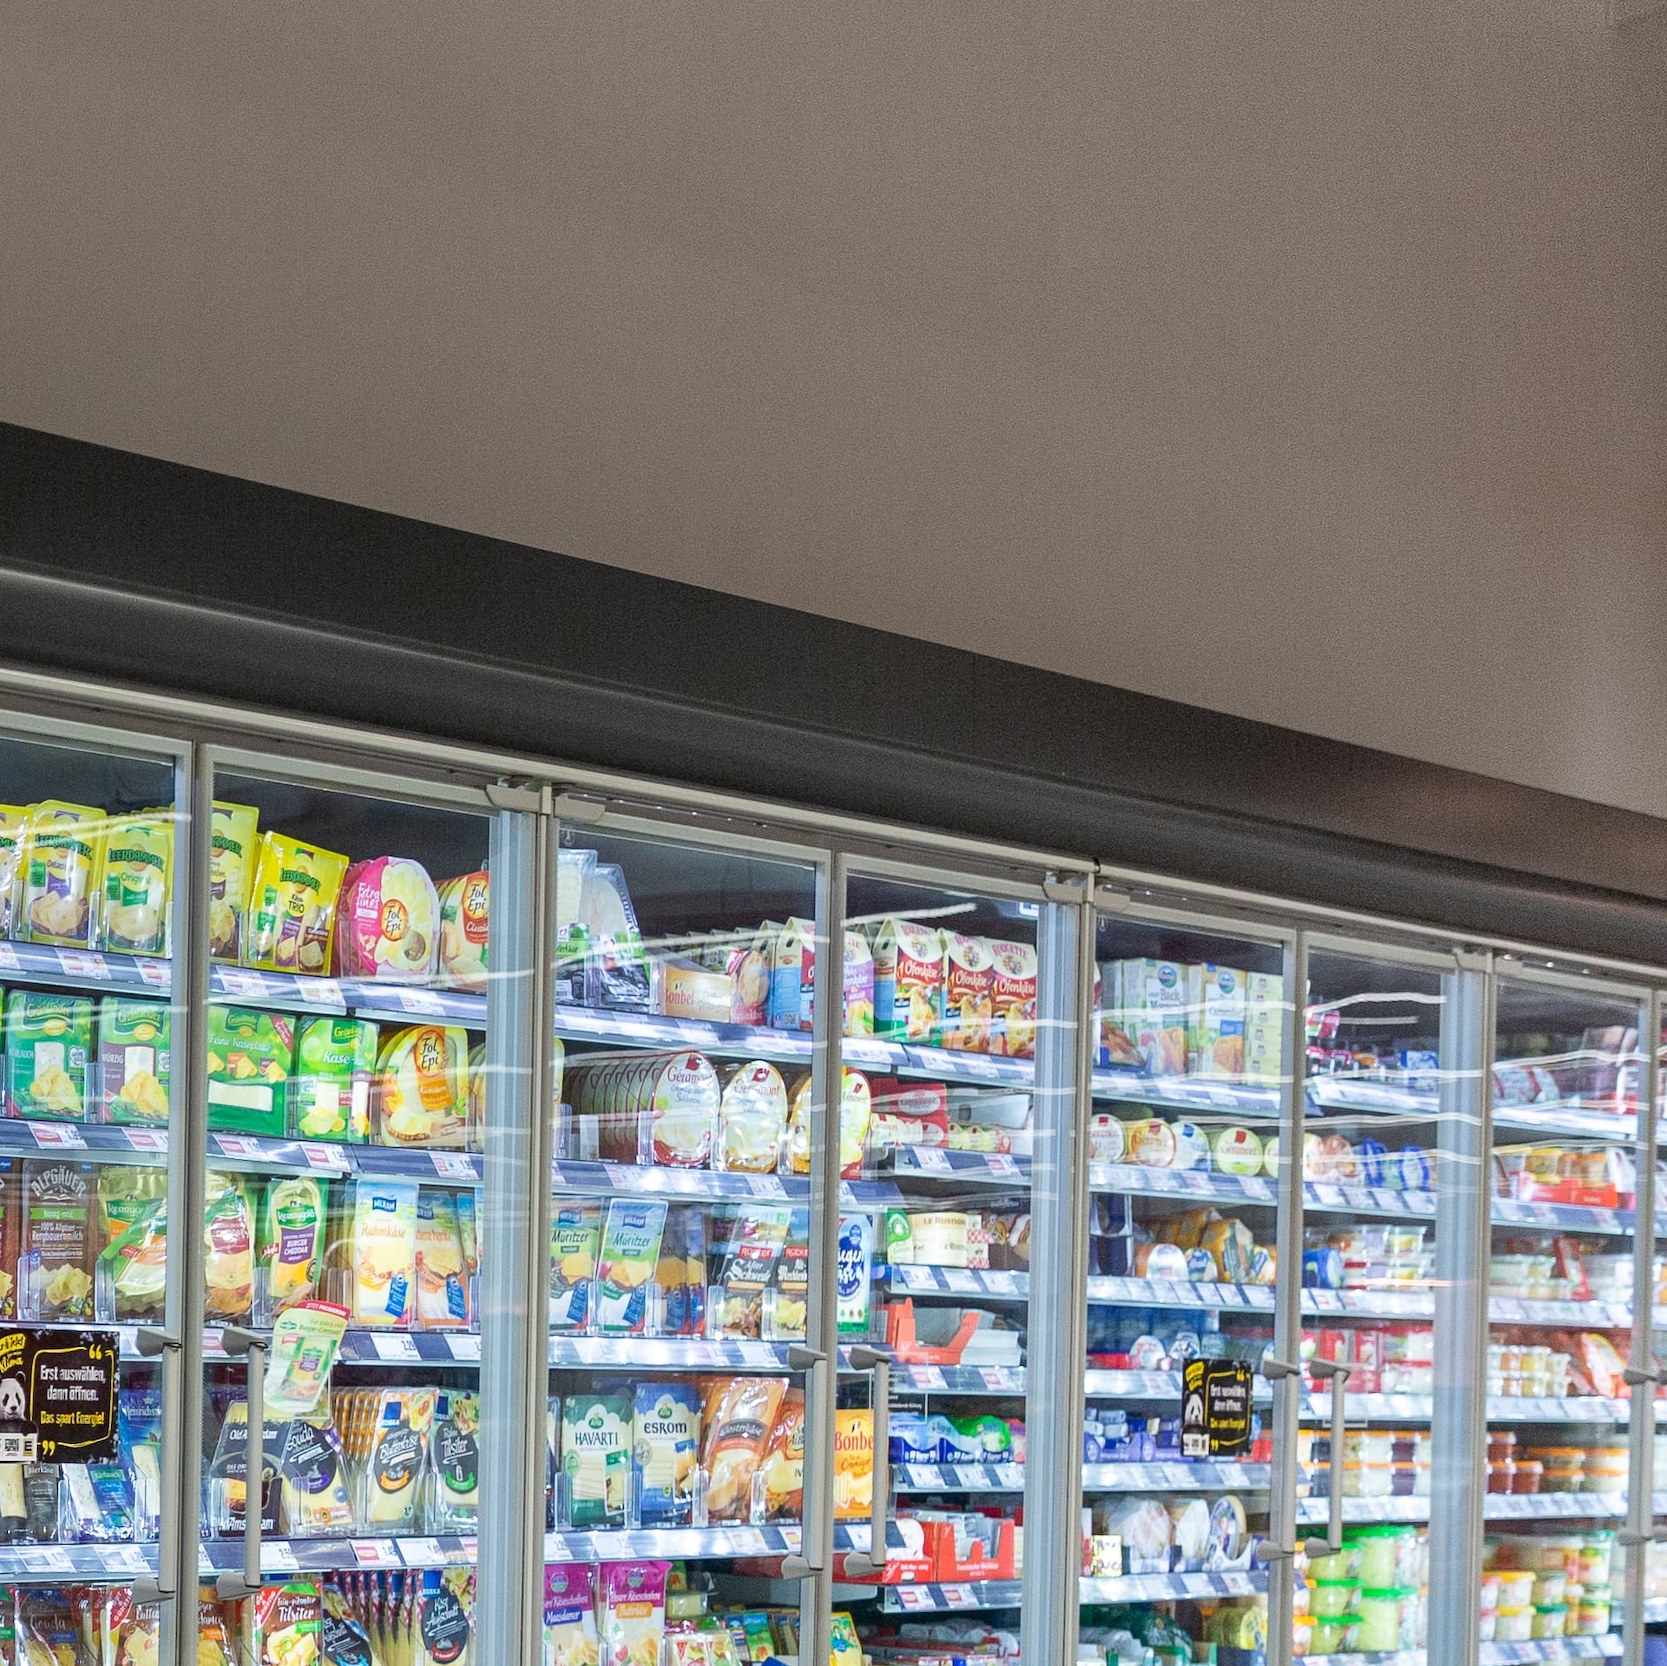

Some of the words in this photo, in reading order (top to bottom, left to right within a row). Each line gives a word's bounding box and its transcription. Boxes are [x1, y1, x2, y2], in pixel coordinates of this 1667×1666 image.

[108, 848, 164, 872] LEERDAMMER
[120, 872, 151, 885] Original
[386, 905, 401, 920] Fol
[385, 919, 401, 935] Epi
[904, 962, 943, 983] Ofenkäse
[31, 1165, 87, 1199] ALPGÄUER
[32, 1229, 84, 1242] Bergbauernmilch
[361, 1222, 406, 1238] Rahmkäse
[613, 1232, 651, 1247] Müritzer
[41, 1365, 58, 1380] Erst
[60, 1366, 106, 1383] auswählen,
[47, 1385, 67, 1401] dann
[69, 1386, 99, 1401] öffnen.
[41, 1411, 54, 1424] Das
[56, 1412, 75, 1427] spart
[76, 1412, 104, 1427] Energie!
[644, 1421, 687, 1434] ESROM
[575, 1432, 618, 1446] HAVARTI
[278, 1606, 315, 1623] Tilsiter
